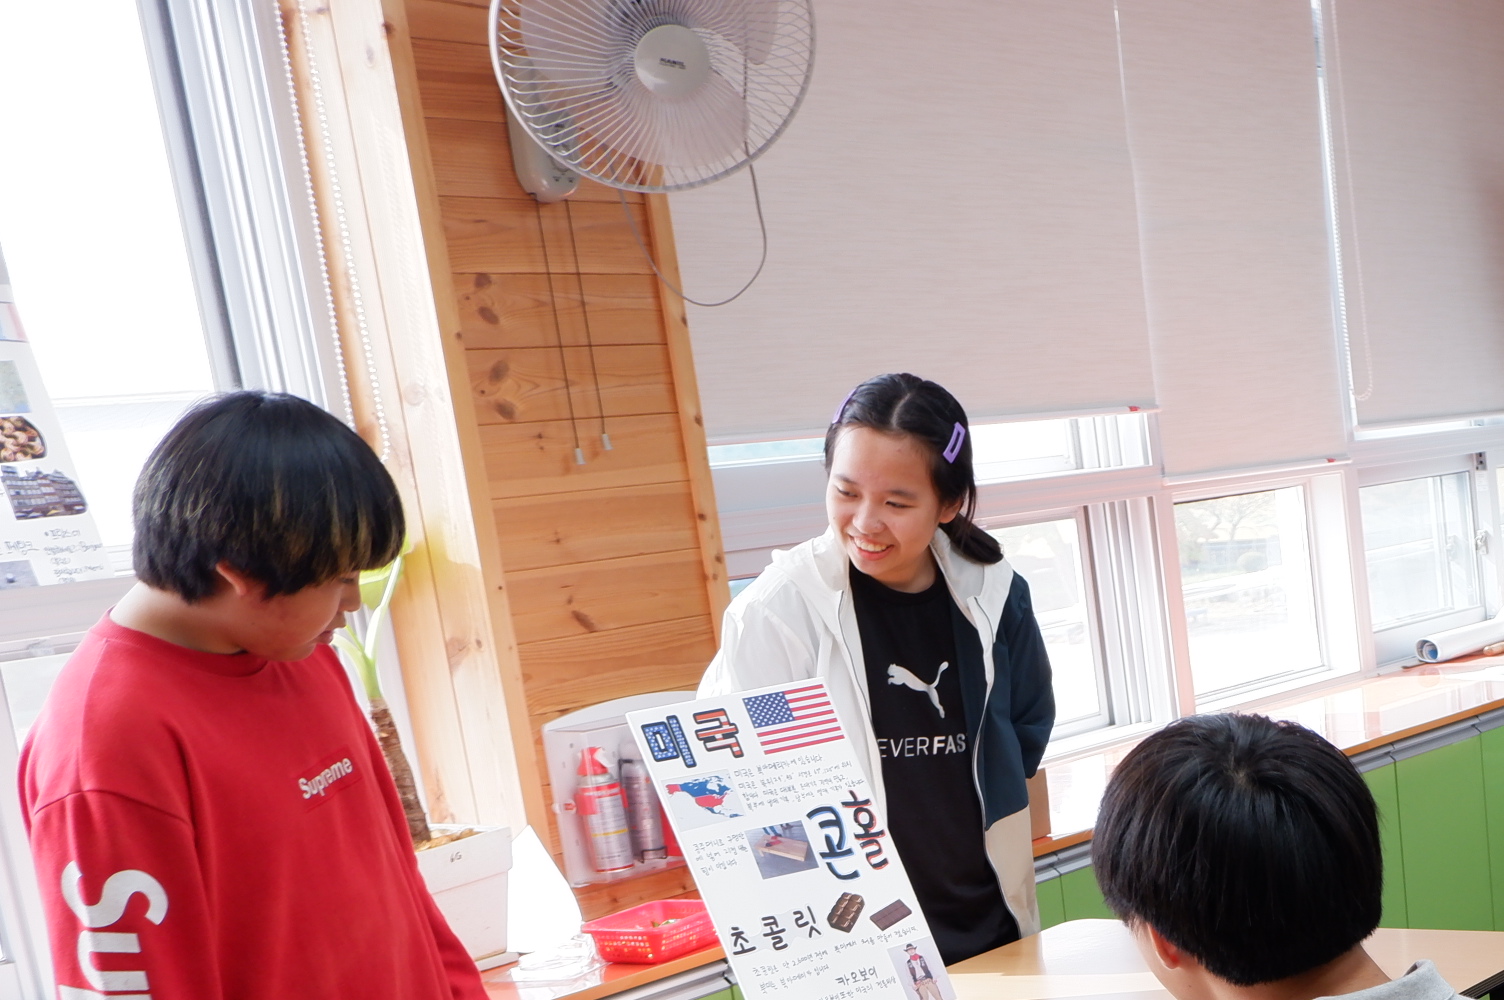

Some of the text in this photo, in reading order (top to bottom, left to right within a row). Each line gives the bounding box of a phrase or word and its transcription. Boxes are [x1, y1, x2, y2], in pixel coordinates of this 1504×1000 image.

[641, 707, 745, 768] 미국
[877, 733, 968, 758] EVER FAS
[298, 755, 354, 801] Supreme
[805, 790, 890, 882] 콘홀
[731, 905, 822, 957] 초콜릿
[834, 965, 879, 987] 카오보이
